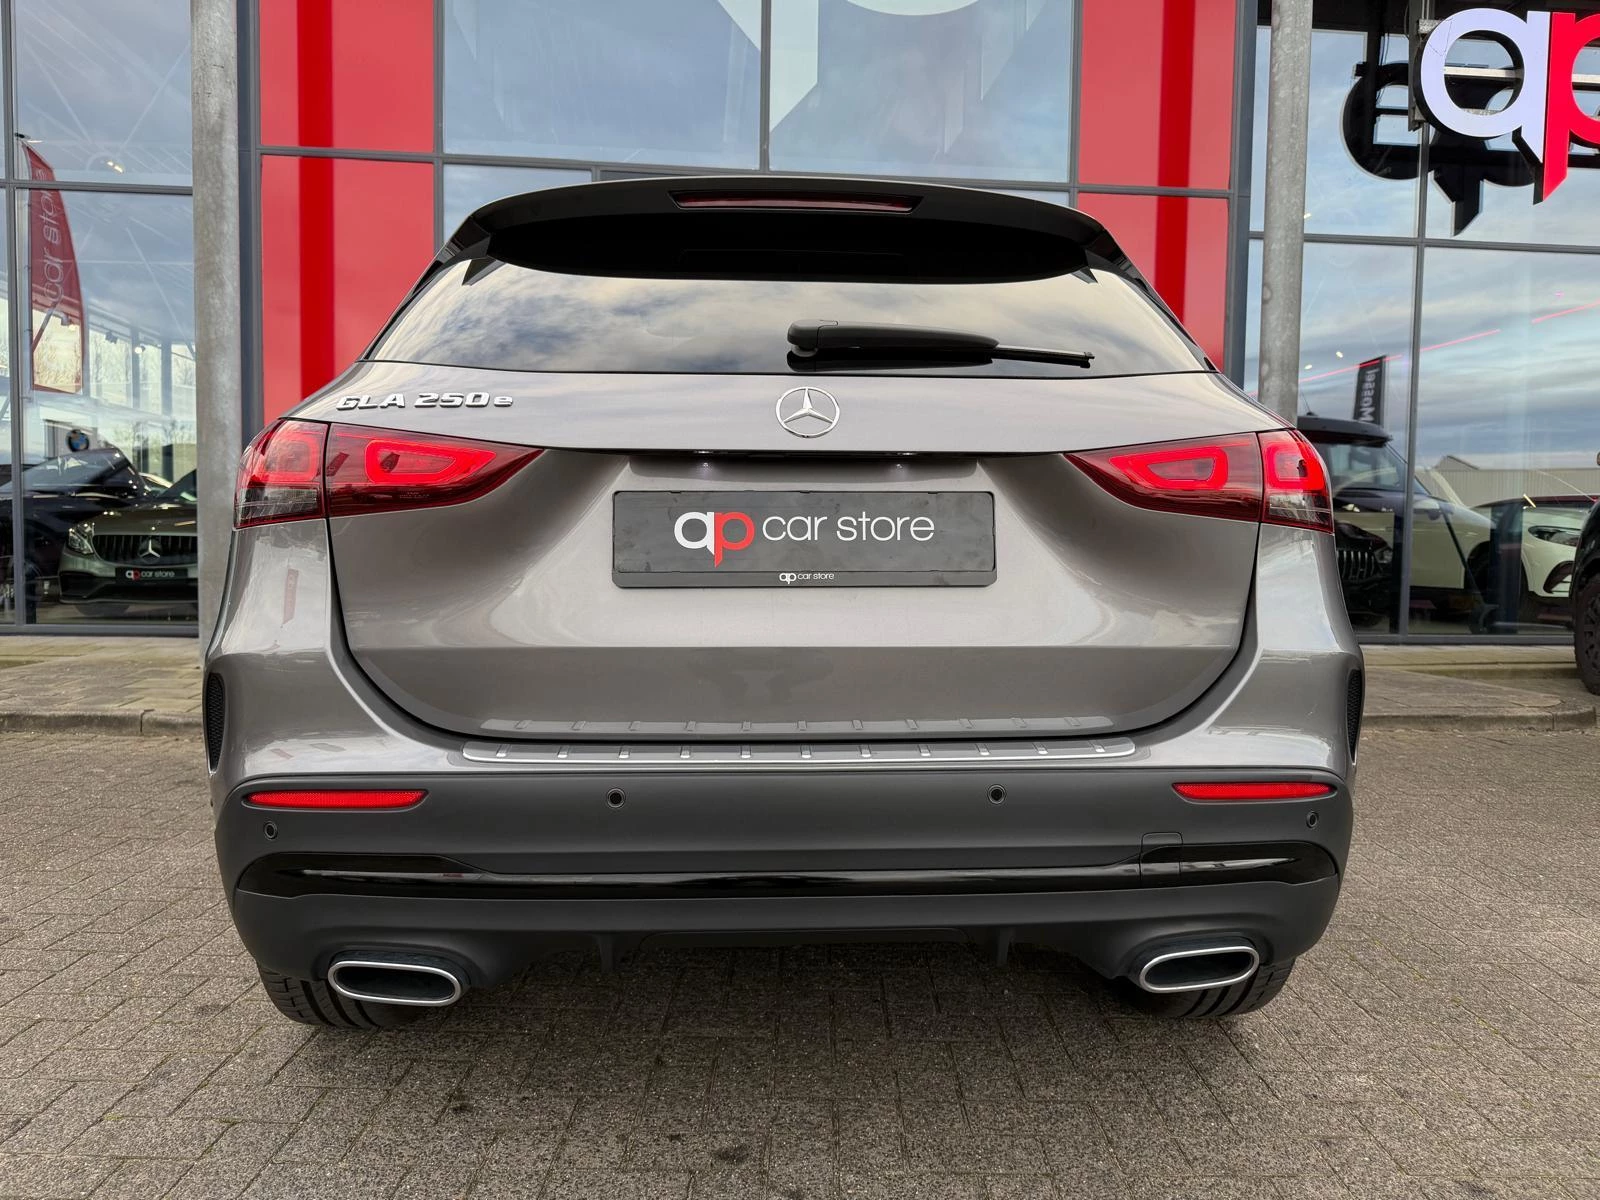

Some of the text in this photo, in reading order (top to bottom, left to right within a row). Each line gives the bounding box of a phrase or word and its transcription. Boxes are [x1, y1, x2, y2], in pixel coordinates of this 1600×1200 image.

[336, 393, 406, 411] GLA
[674, 511, 935, 568] ap car store
